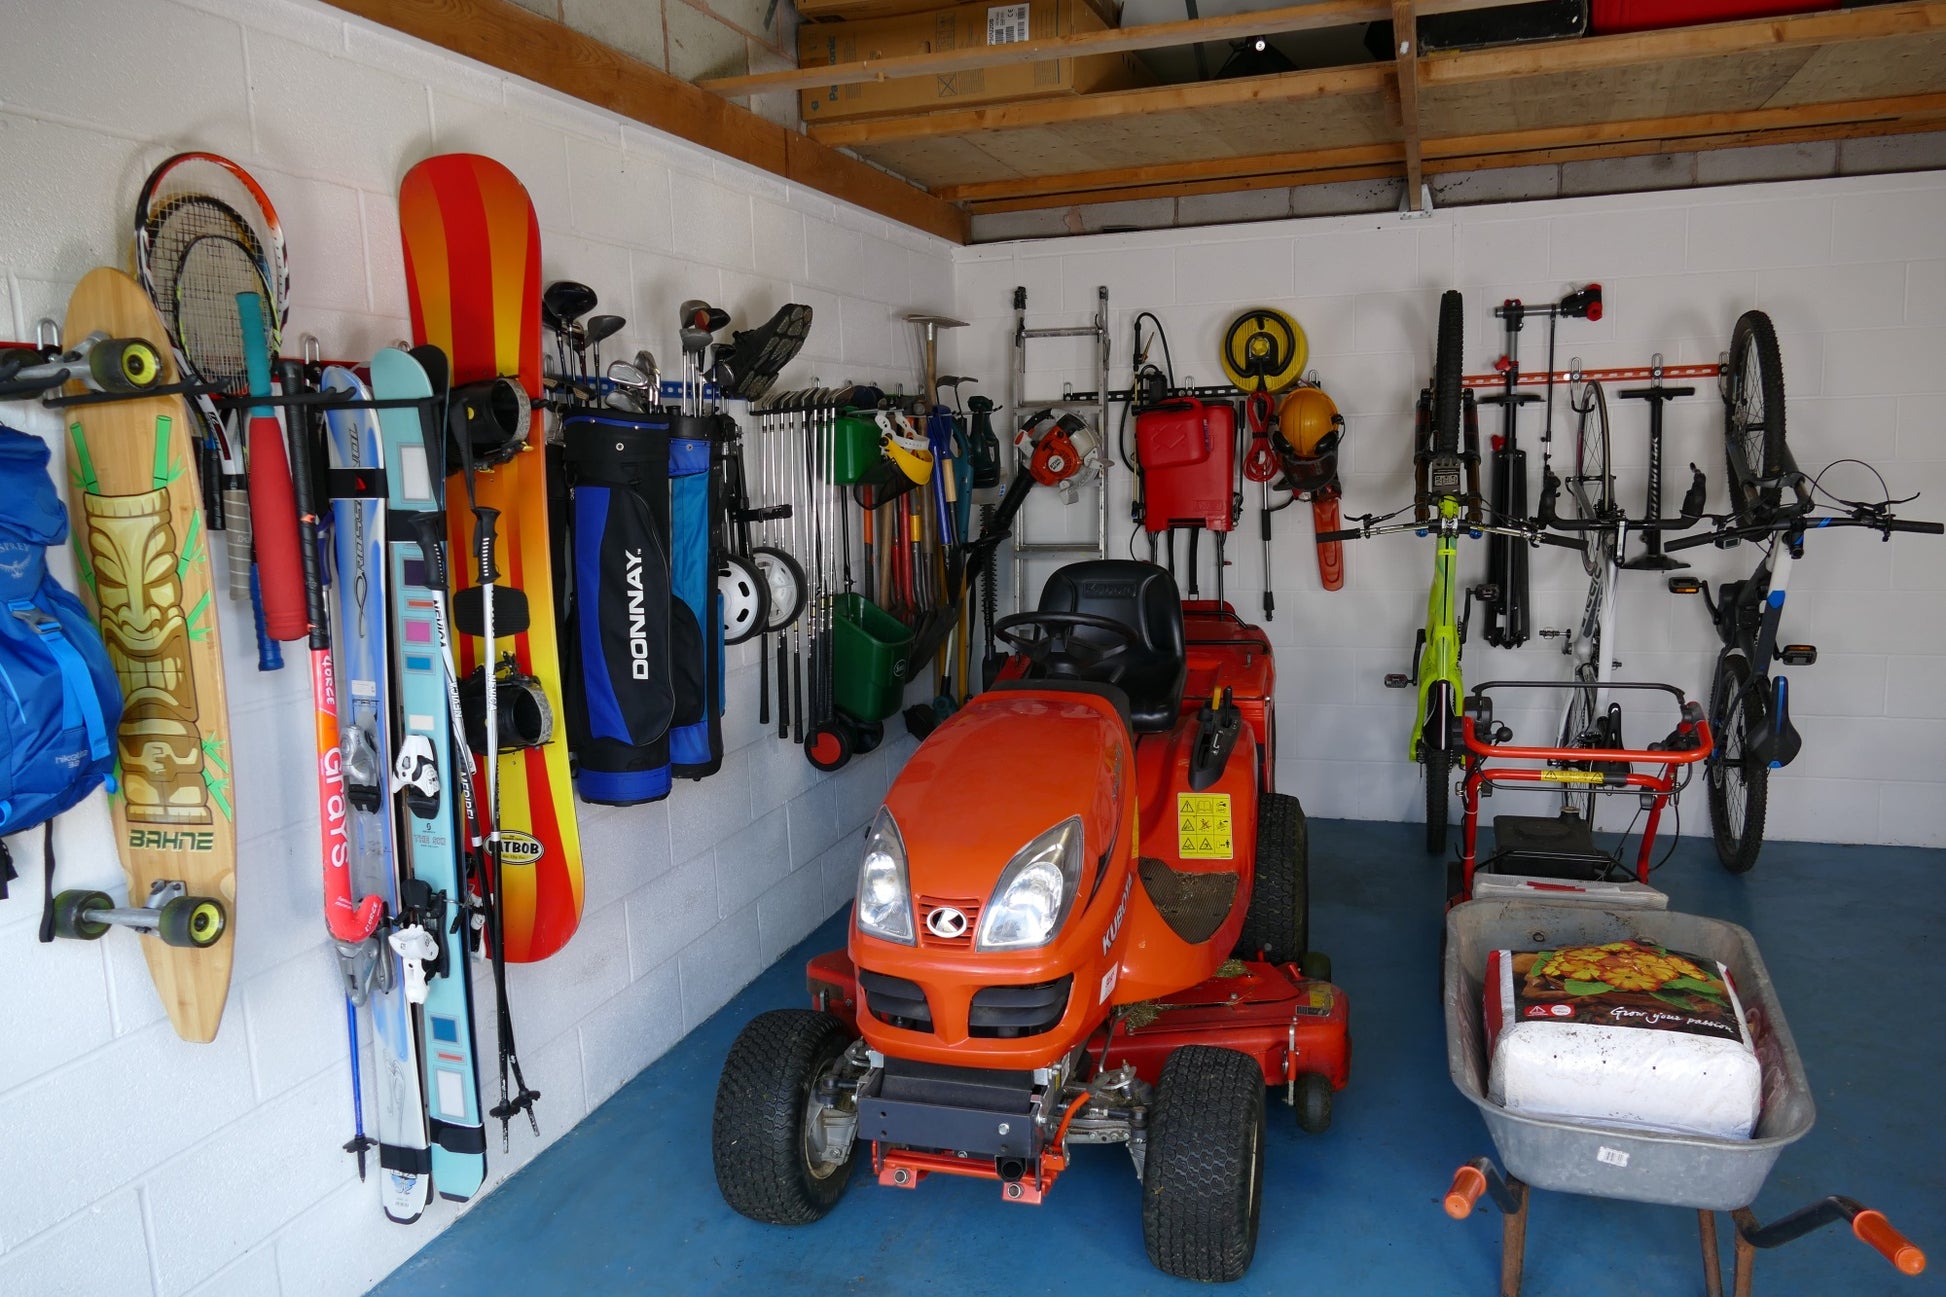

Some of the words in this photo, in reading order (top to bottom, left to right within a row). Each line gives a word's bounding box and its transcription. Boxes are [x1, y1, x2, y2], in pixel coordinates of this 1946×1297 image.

[828, 35, 838, 101] Paonic
[625, 550, 649, 680] DONNAY
[487, 840, 539, 854] TBOB
[1610, 1006, 1648, 1021] Grow
[1645, 1012, 1682, 1024] your
[1686, 1017, 1735, 1033] passion
